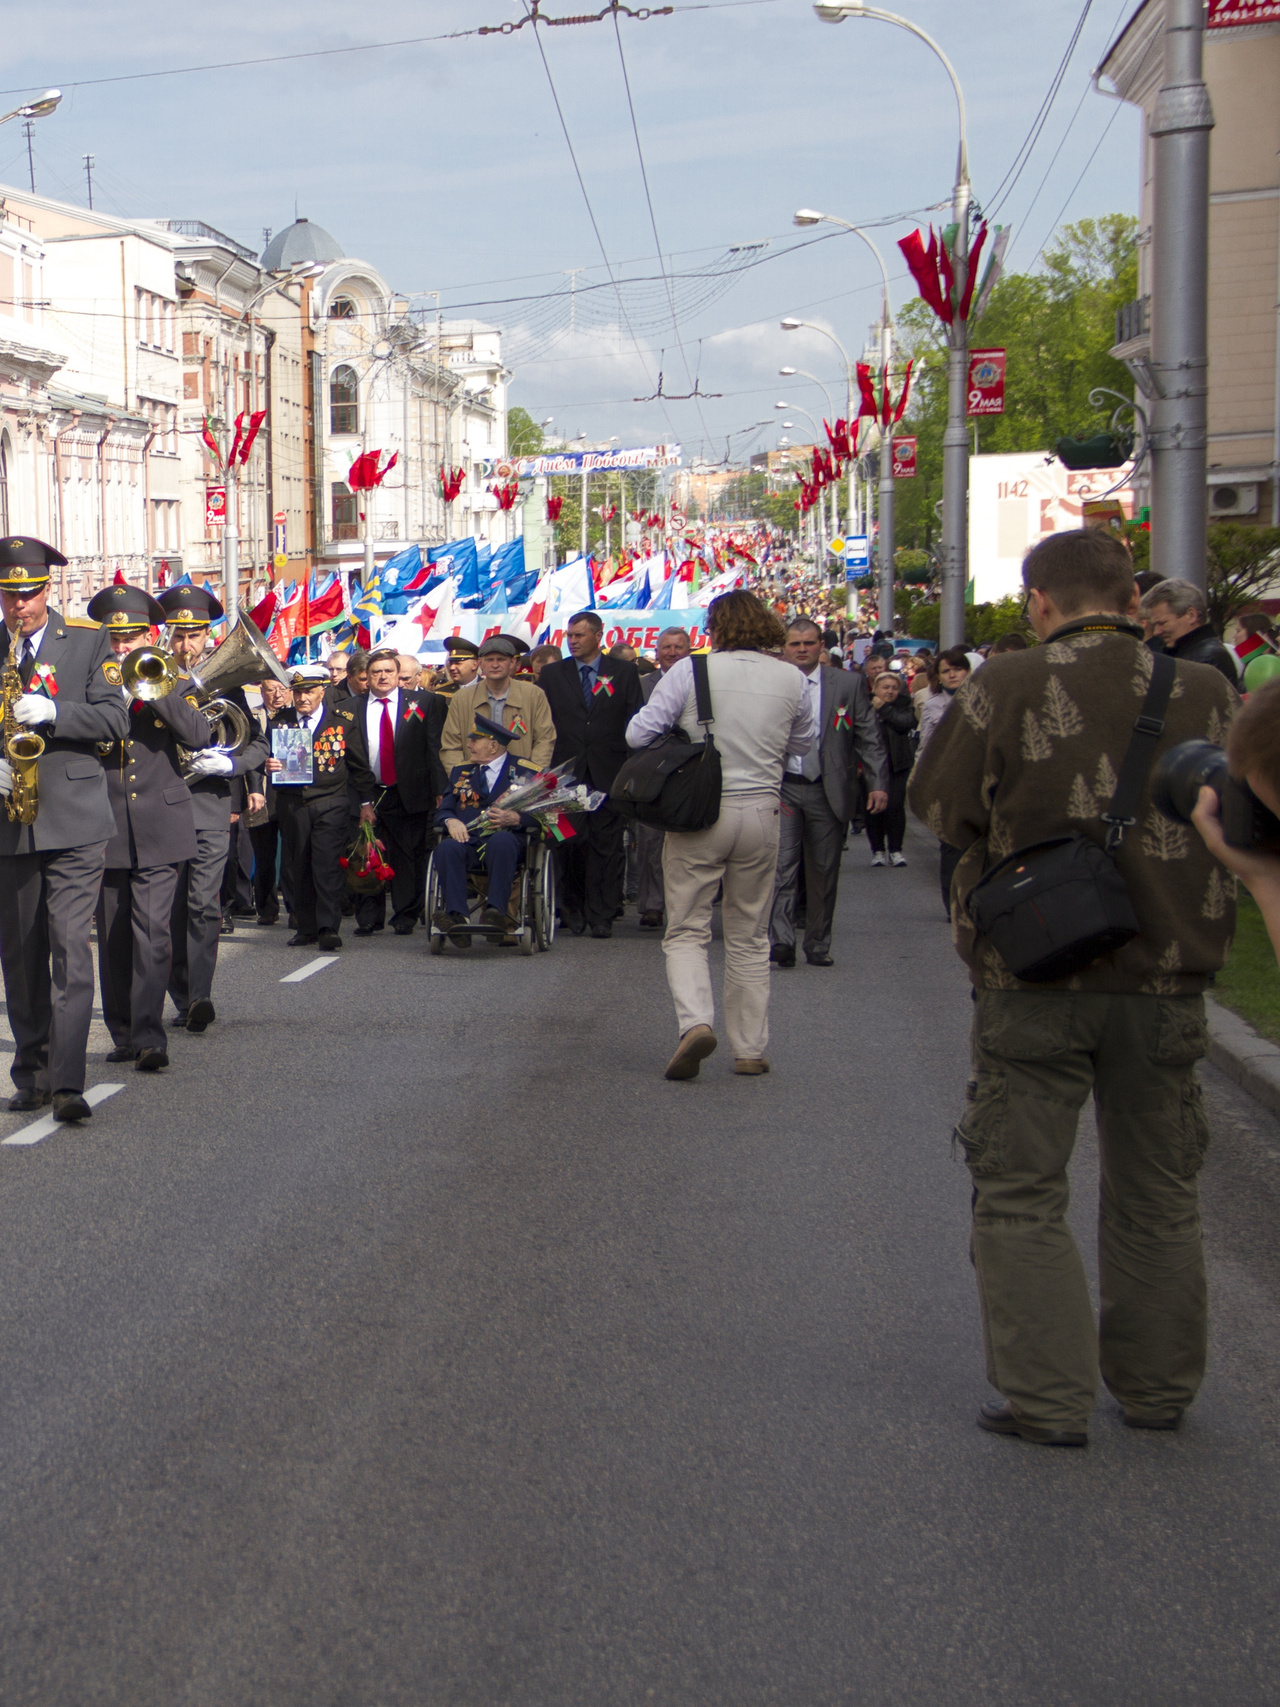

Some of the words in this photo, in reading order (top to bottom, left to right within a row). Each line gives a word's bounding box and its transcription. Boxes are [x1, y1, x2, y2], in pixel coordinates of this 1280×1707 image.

[1212, 5, 1280, 22] 1941-194
[968, 390, 982, 409] 9
[979, 397, 1003, 407] МАЯ
[516, 460, 527, 475] С
[531, 457, 576, 476] Днём
[582, 452, 645, 471] Победы!
[893, 462, 902, 474] 9
[998, 480, 1029, 499] 1142
[207, 510, 215, 522] 9
